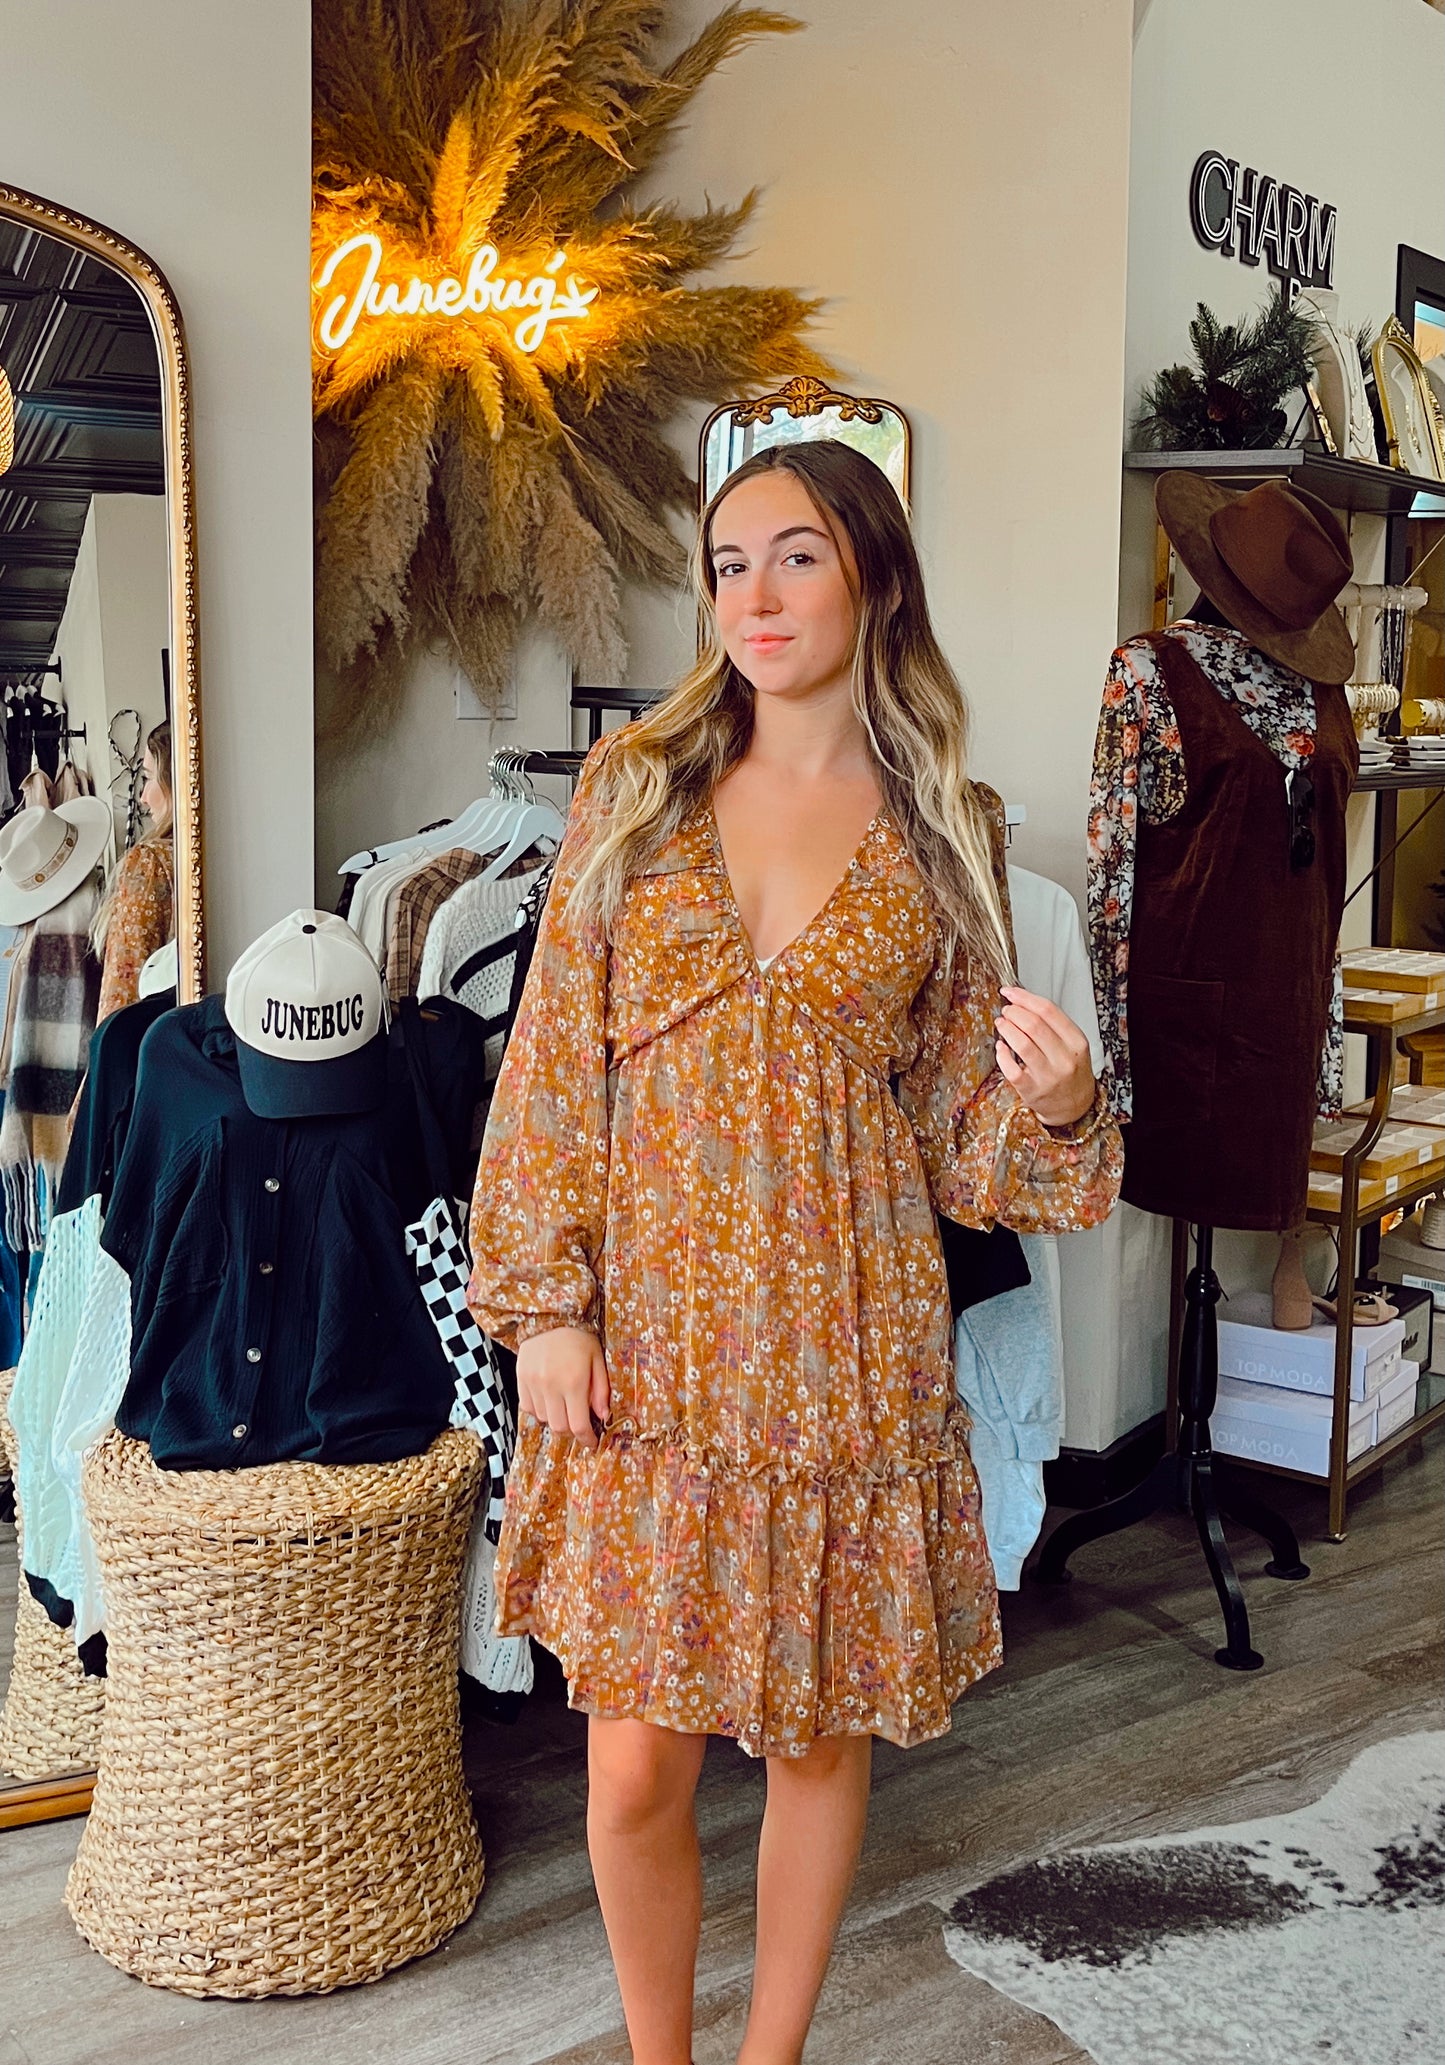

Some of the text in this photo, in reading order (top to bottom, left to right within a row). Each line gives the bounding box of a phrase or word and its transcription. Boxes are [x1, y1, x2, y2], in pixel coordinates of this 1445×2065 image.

[1191, 151, 1337, 289] CHARM
[316, 233, 599, 352] Junebug's
[261, 993, 364, 1041] JUNEBUG
[1233, 1359, 1327, 1388] TOP MODA
[1215, 1431, 1298, 1461] OP MODA
